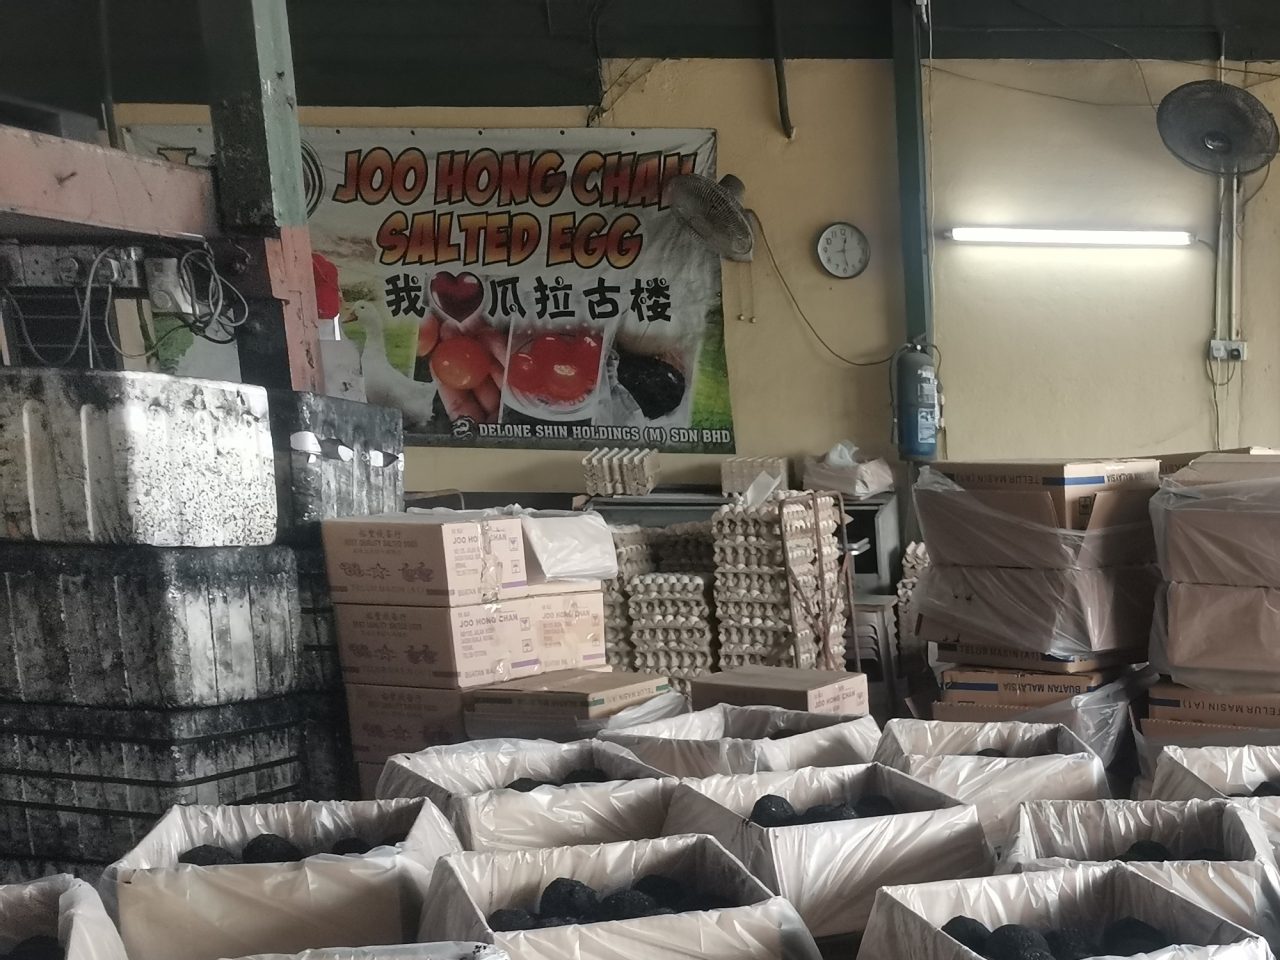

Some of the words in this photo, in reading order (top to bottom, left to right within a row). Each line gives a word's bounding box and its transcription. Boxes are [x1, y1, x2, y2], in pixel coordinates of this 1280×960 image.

[332, 147, 429, 206] JOO
[435, 147, 569, 207] HONG
[376, 210, 541, 268] SALTED
[547, 211, 644, 270] EGG
[385, 274, 427, 319] 我
[479, 424, 532, 438] DELONE
[535, 425, 569, 439] SHIN
[572, 426, 640, 441] HOLDINGS
[643, 427, 668, 444] (M)
[671, 429, 700, 443] SDN
[702, 429, 732, 444] BHD
[1003, 682, 1046, 694] MALAYSIA
[1048, 684, 1081, 694] BUATAN
[1183, 700, 1206, 711] (A1)
[1207, 703, 1244, 713] MASIN
